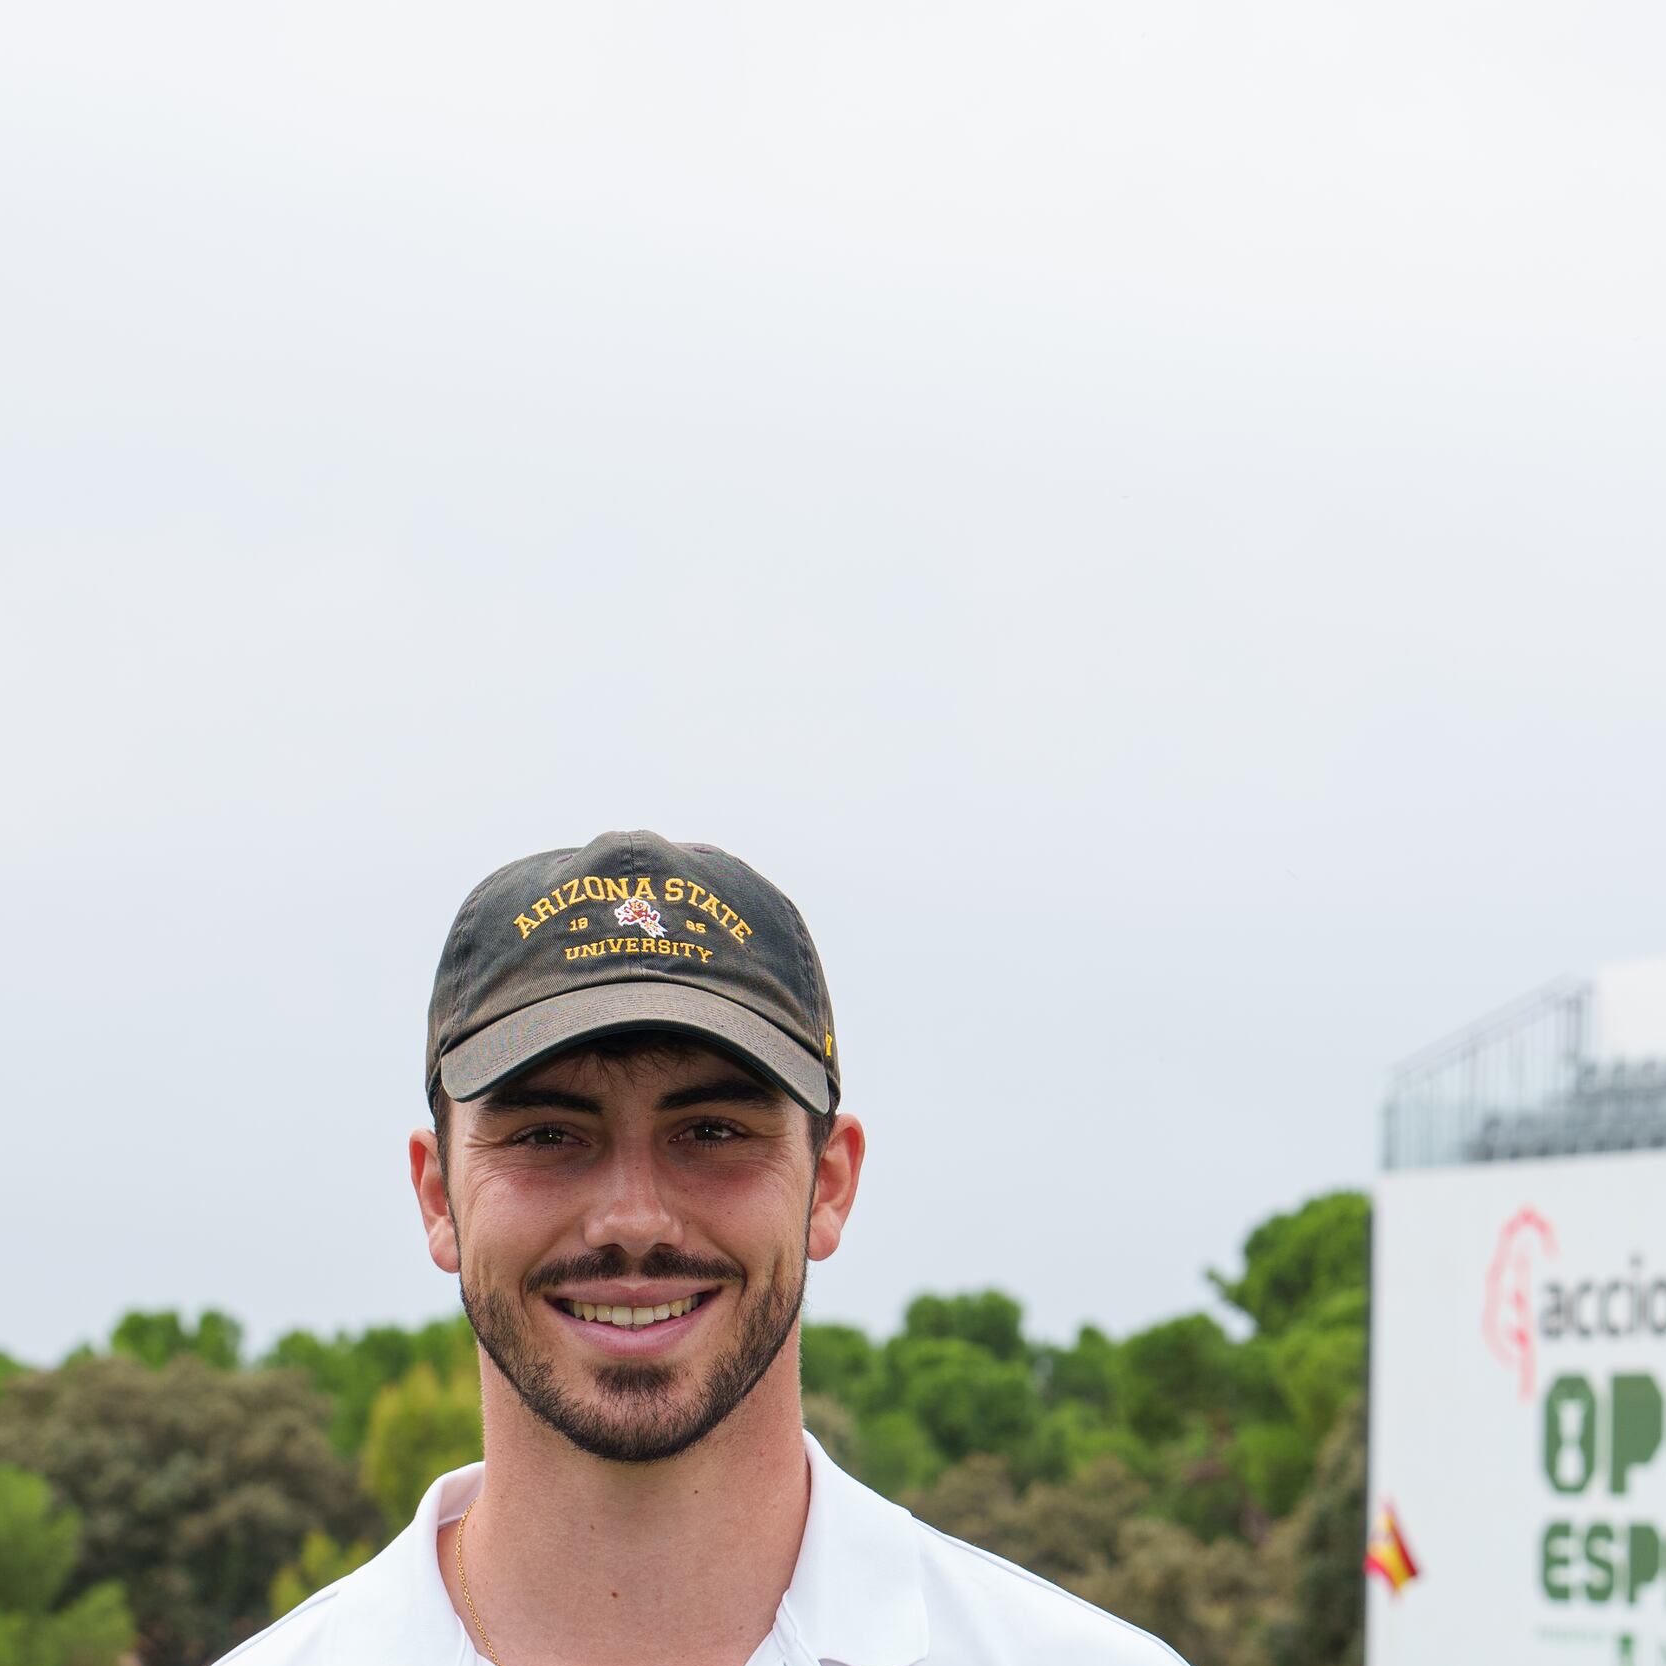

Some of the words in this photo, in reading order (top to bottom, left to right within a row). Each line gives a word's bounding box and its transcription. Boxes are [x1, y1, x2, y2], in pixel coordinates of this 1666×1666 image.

[513, 875, 657, 940] ARIZONA
[664, 877, 754, 945] STATE
[568, 917, 589, 932] 18
[565, 937, 714, 964] UNIVERSITY
